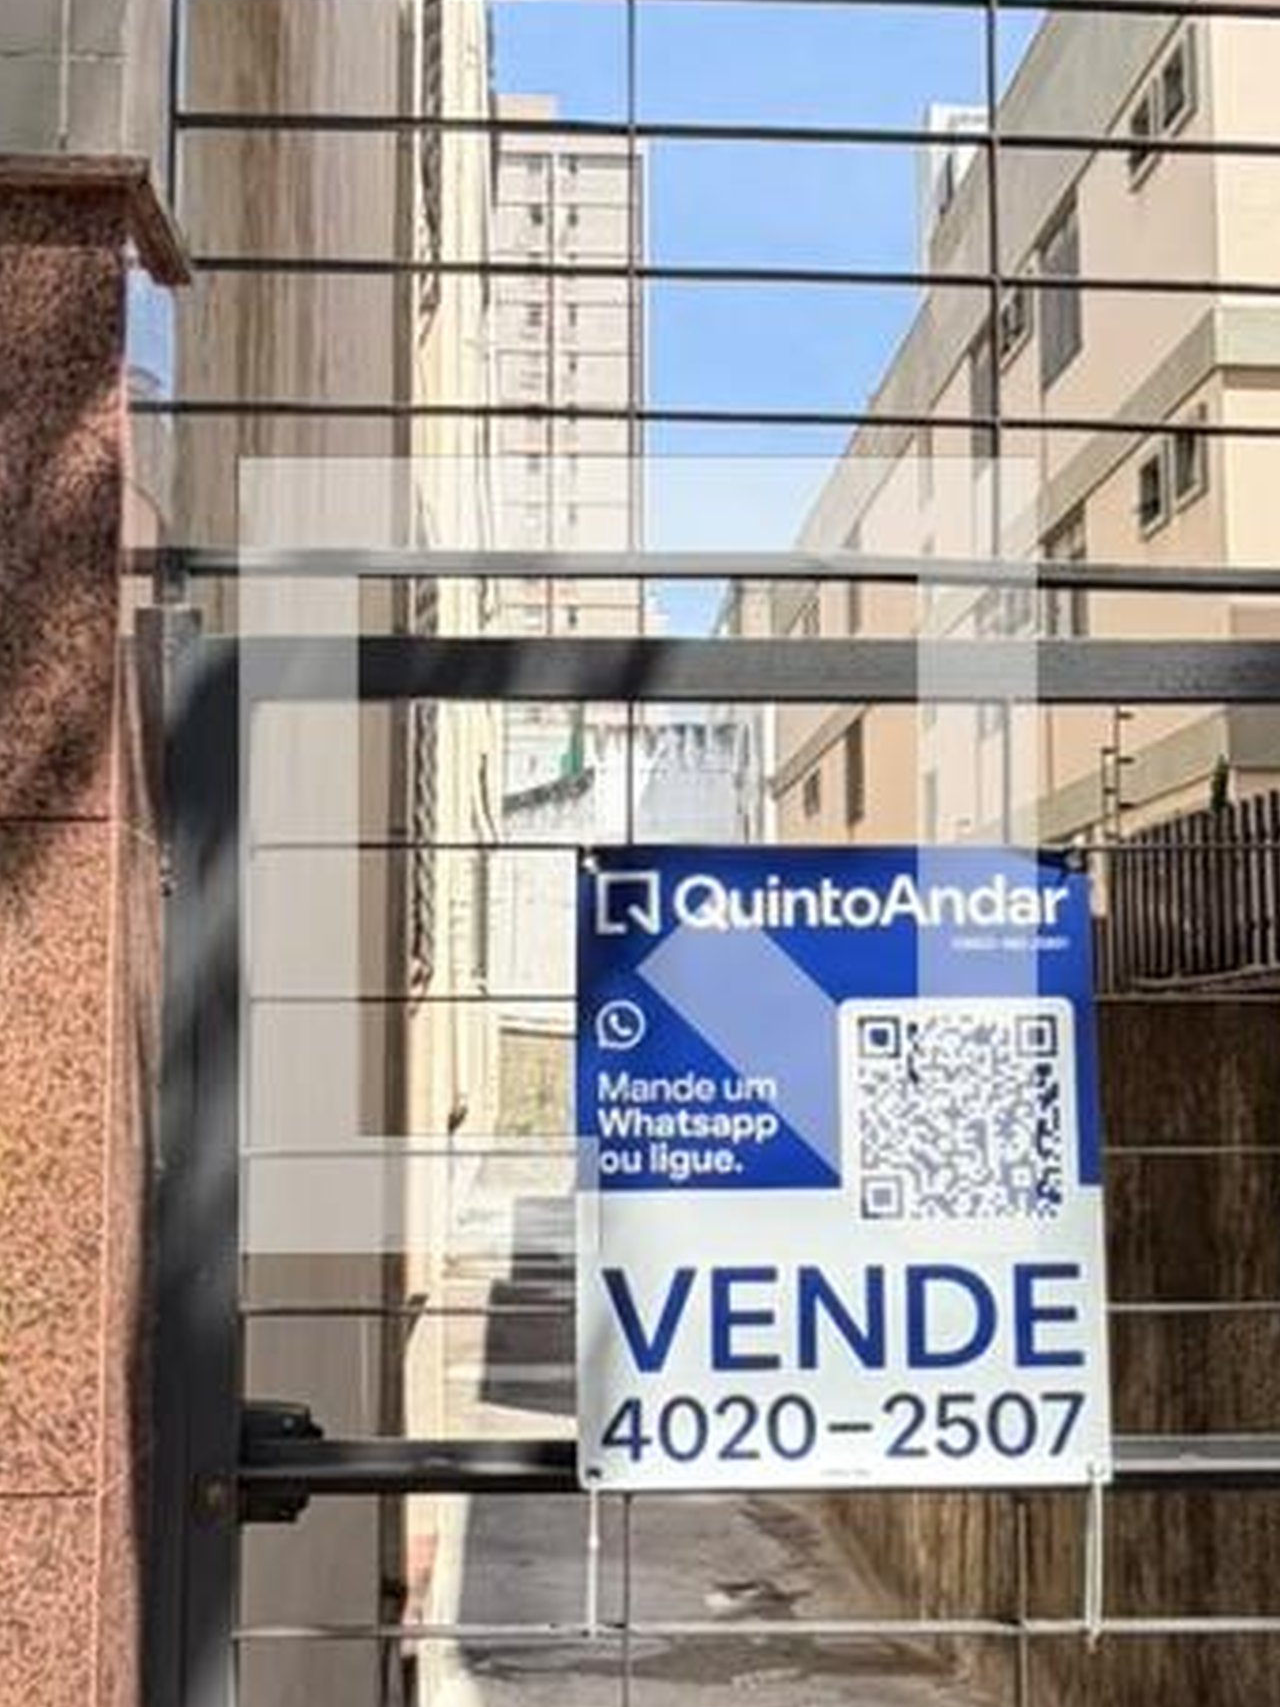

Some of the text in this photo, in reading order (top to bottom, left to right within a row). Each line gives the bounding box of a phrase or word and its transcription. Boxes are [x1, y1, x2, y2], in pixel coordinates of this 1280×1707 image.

[674, 873, 1068, 929] QuintoAndar
[597, 1071, 777, 1103] Mande um
[597, 1107, 779, 1145] Whatsapp
[599, 1142, 744, 1181] ou ligue.
[602, 1263, 1086, 1374] VENDE
[601, 1392, 1086, 1462] 4020-2507
